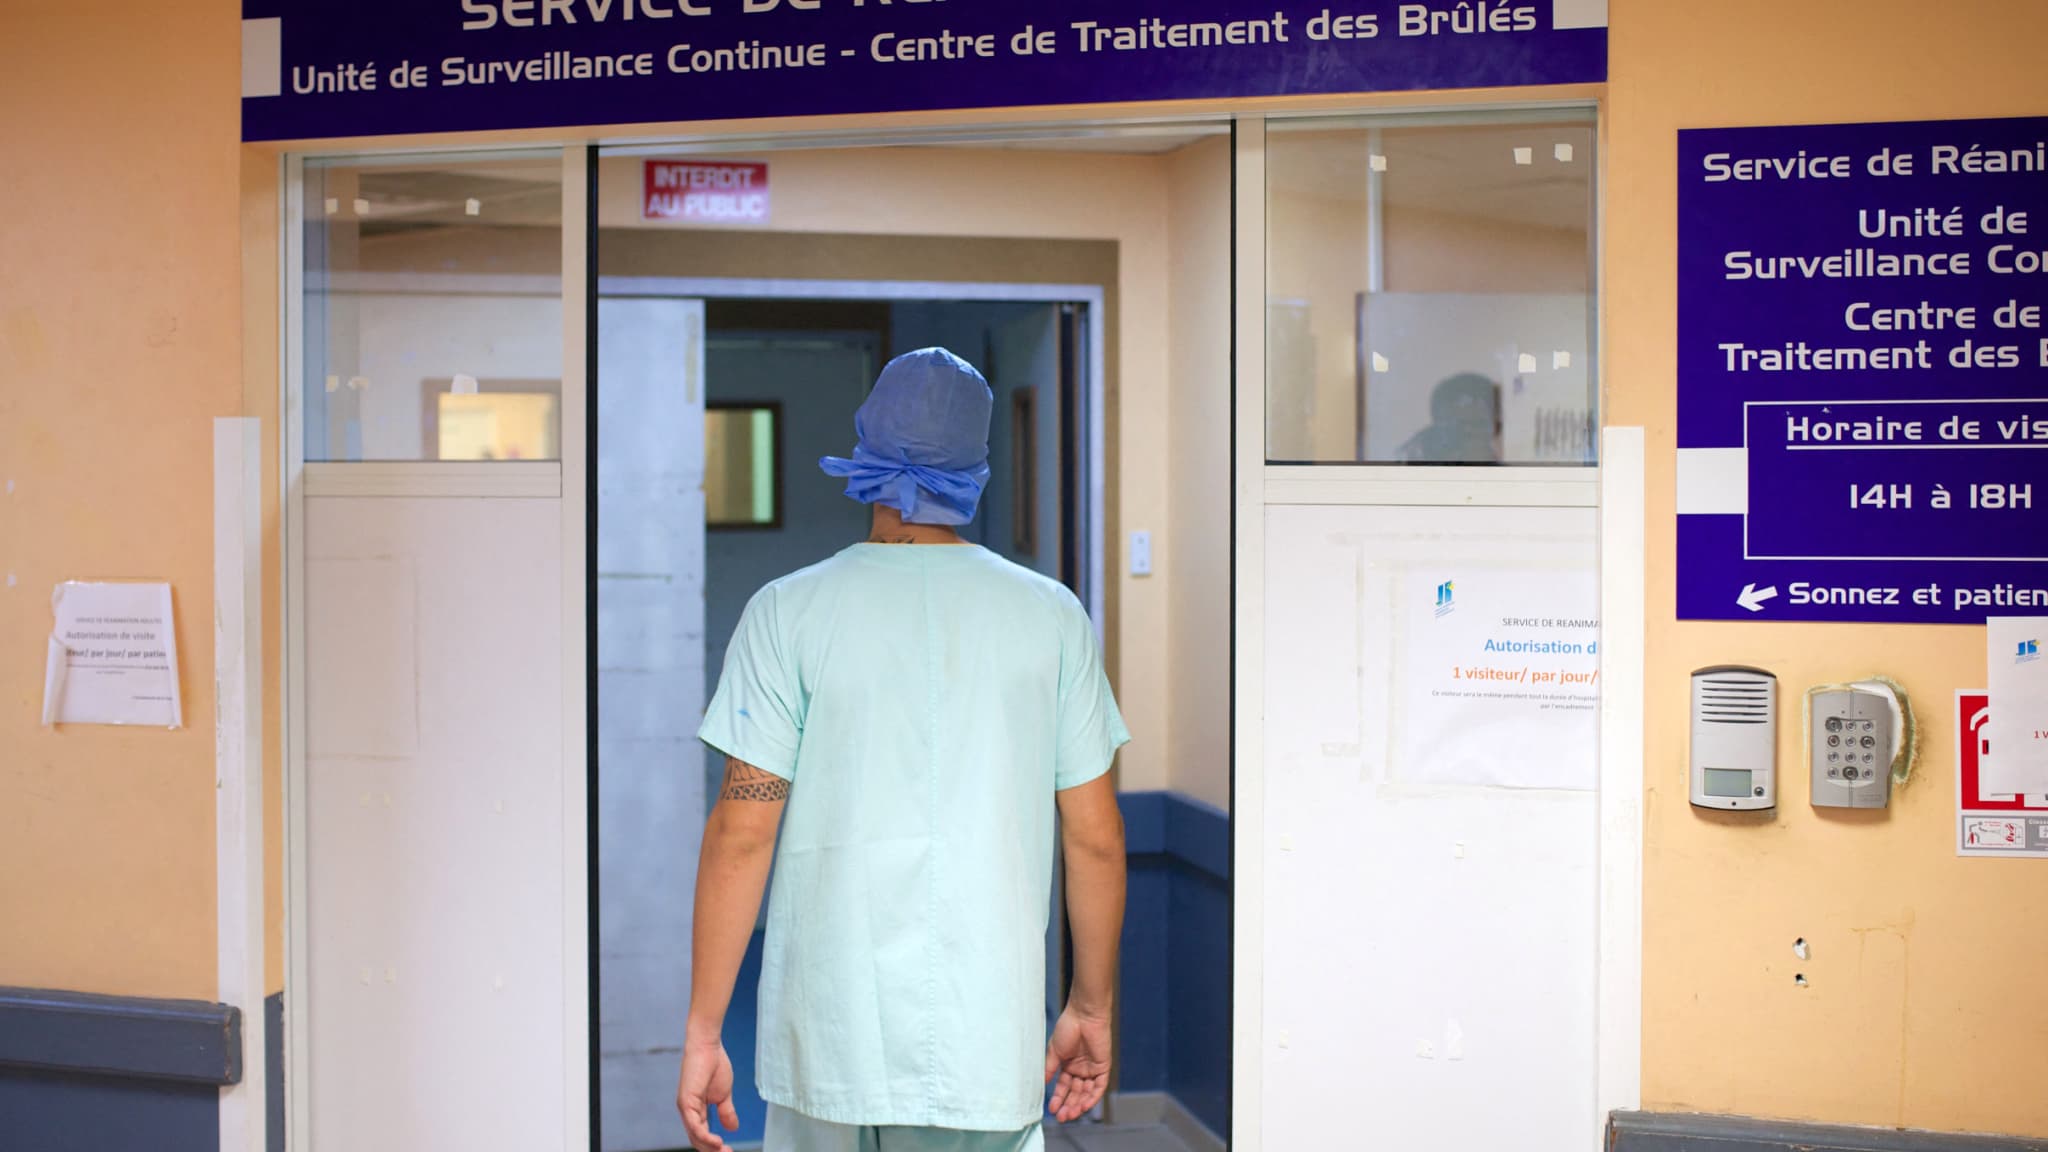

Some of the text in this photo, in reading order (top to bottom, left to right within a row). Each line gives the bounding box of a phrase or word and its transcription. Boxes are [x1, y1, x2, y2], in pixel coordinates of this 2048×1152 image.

[293, 62, 376, 94] Unité
[389, 60, 427, 89] de
[441, 51, 653, 86] Surveillance
[667, 40, 825, 73] Continue
[870, 29, 995, 63] Centre
[1010, 25, 1056, 55] de
[1071, 11, 1289, 52] Traitement
[1306, 9, 1379, 41] des
[1398, 1, 1537, 37] Brûlés
[1703, 142, 2045, 182] Service de Réani
[655, 165, 754, 189] INTERDIT
[648, 193, 765, 218] AU PUBLIC
[1859, 205, 2027, 238] Unité de
[1724, 244, 2048, 280] Surveillance Co
[1844, 299, 2040, 331] Centre de
[1718, 340, 1932, 372] Traitement
[1948, 339, 2020, 368] des
[1787, 414, 2048, 442] Horaire de vis
[1850, 483, 2032, 509] 14H à 18H
[1788, 582, 2048, 611] Sonnez et patien
[1502, 617, 1539, 627] SERVICE
[1541, 618, 1553, 628] DE
[1484, 639, 1597, 655] Autorisation d
[1453, 667, 1598, 685] 1 visiteur/ par jour/
